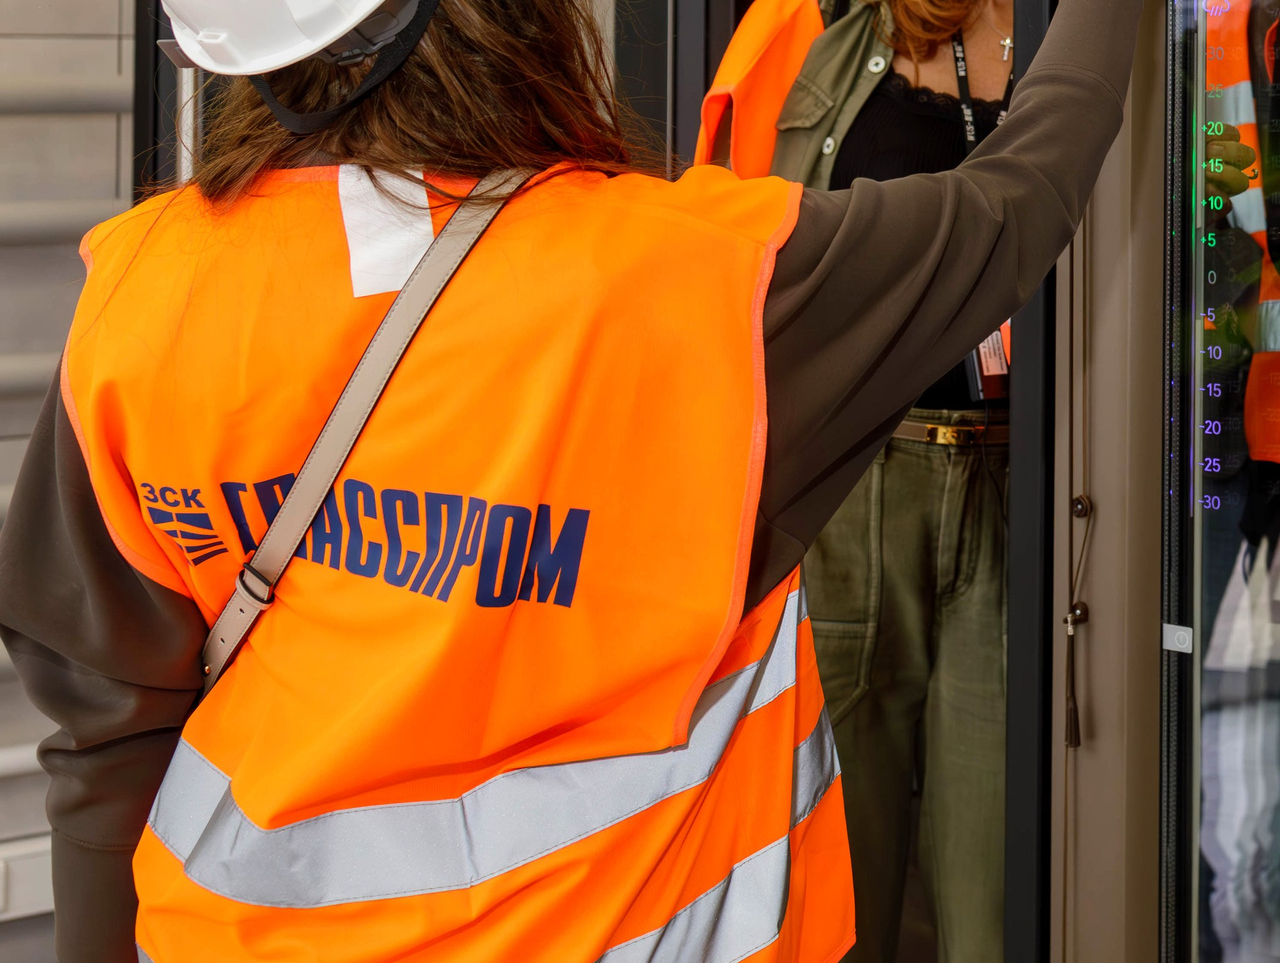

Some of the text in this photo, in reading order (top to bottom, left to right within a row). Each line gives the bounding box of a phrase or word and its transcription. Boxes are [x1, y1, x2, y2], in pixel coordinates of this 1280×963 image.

[1201, 121, 1224, 136] +20
[1201, 158, 1224, 173] +15
[1201, 196, 1224, 211] +10
[1201, 233, 1217, 247] +5
[1207, 270, 1217, 285] 0
[1200, 308, 1216, 322] -5
[1200, 345, 1222, 360] -10
[1199, 383, 1222, 397] -15
[1199, 420, 1222, 435] -20
[1198, 457, 1221, 472] -25
[140, 482, 205, 509] ЗСК
[1198, 495, 1221, 510] -30
